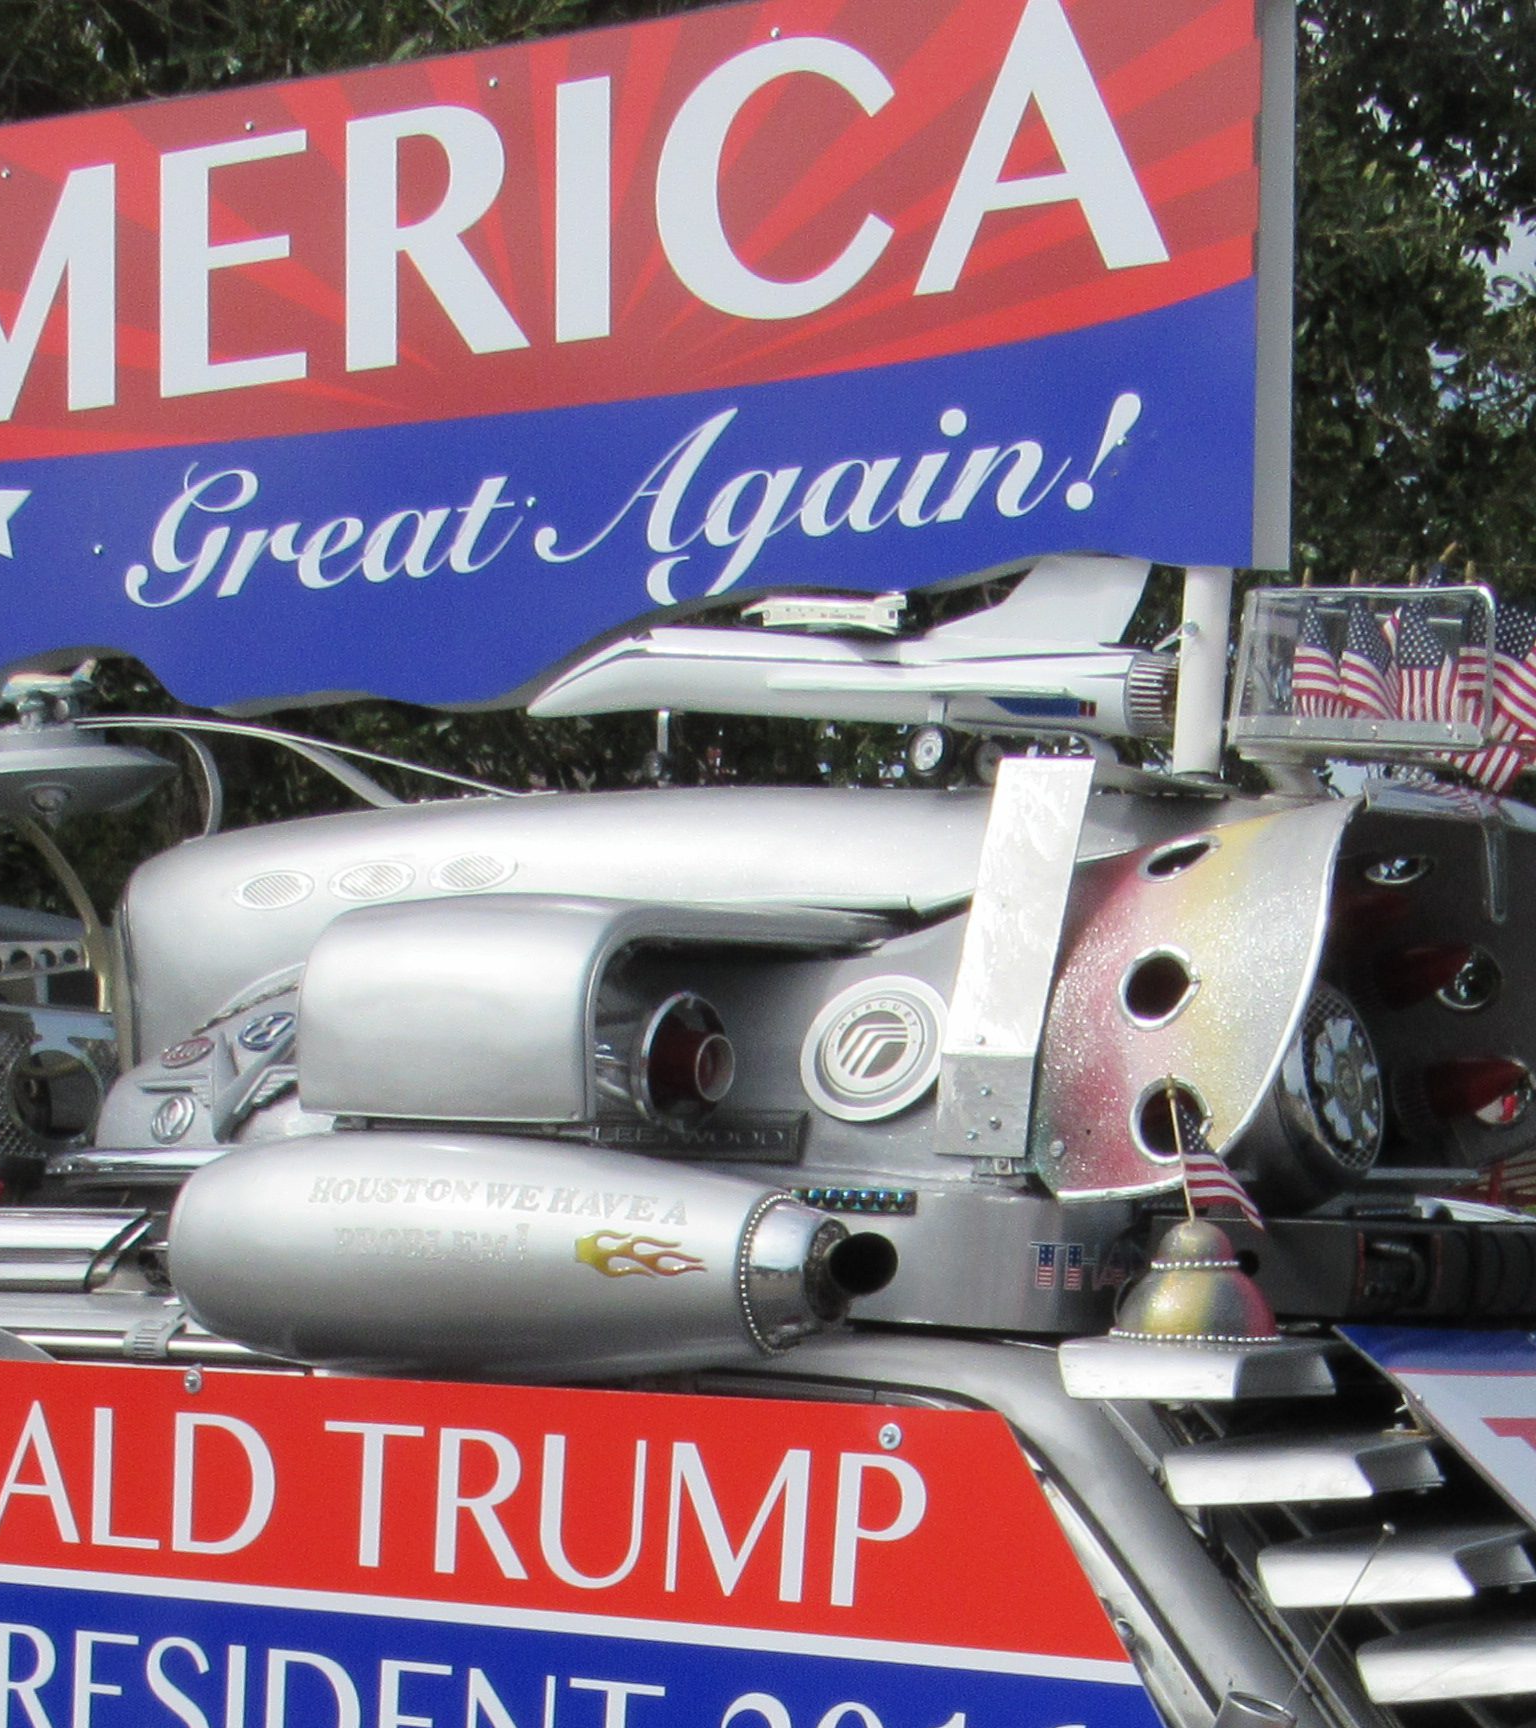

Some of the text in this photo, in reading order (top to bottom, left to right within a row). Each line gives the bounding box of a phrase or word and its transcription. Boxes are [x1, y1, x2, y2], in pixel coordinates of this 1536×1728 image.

[125, 392, 1142, 608] Great Again!
[307, 1176, 689, 1226] HOUSTON WE HAVE A
[324, 1418, 927, 1606] TRUMP
